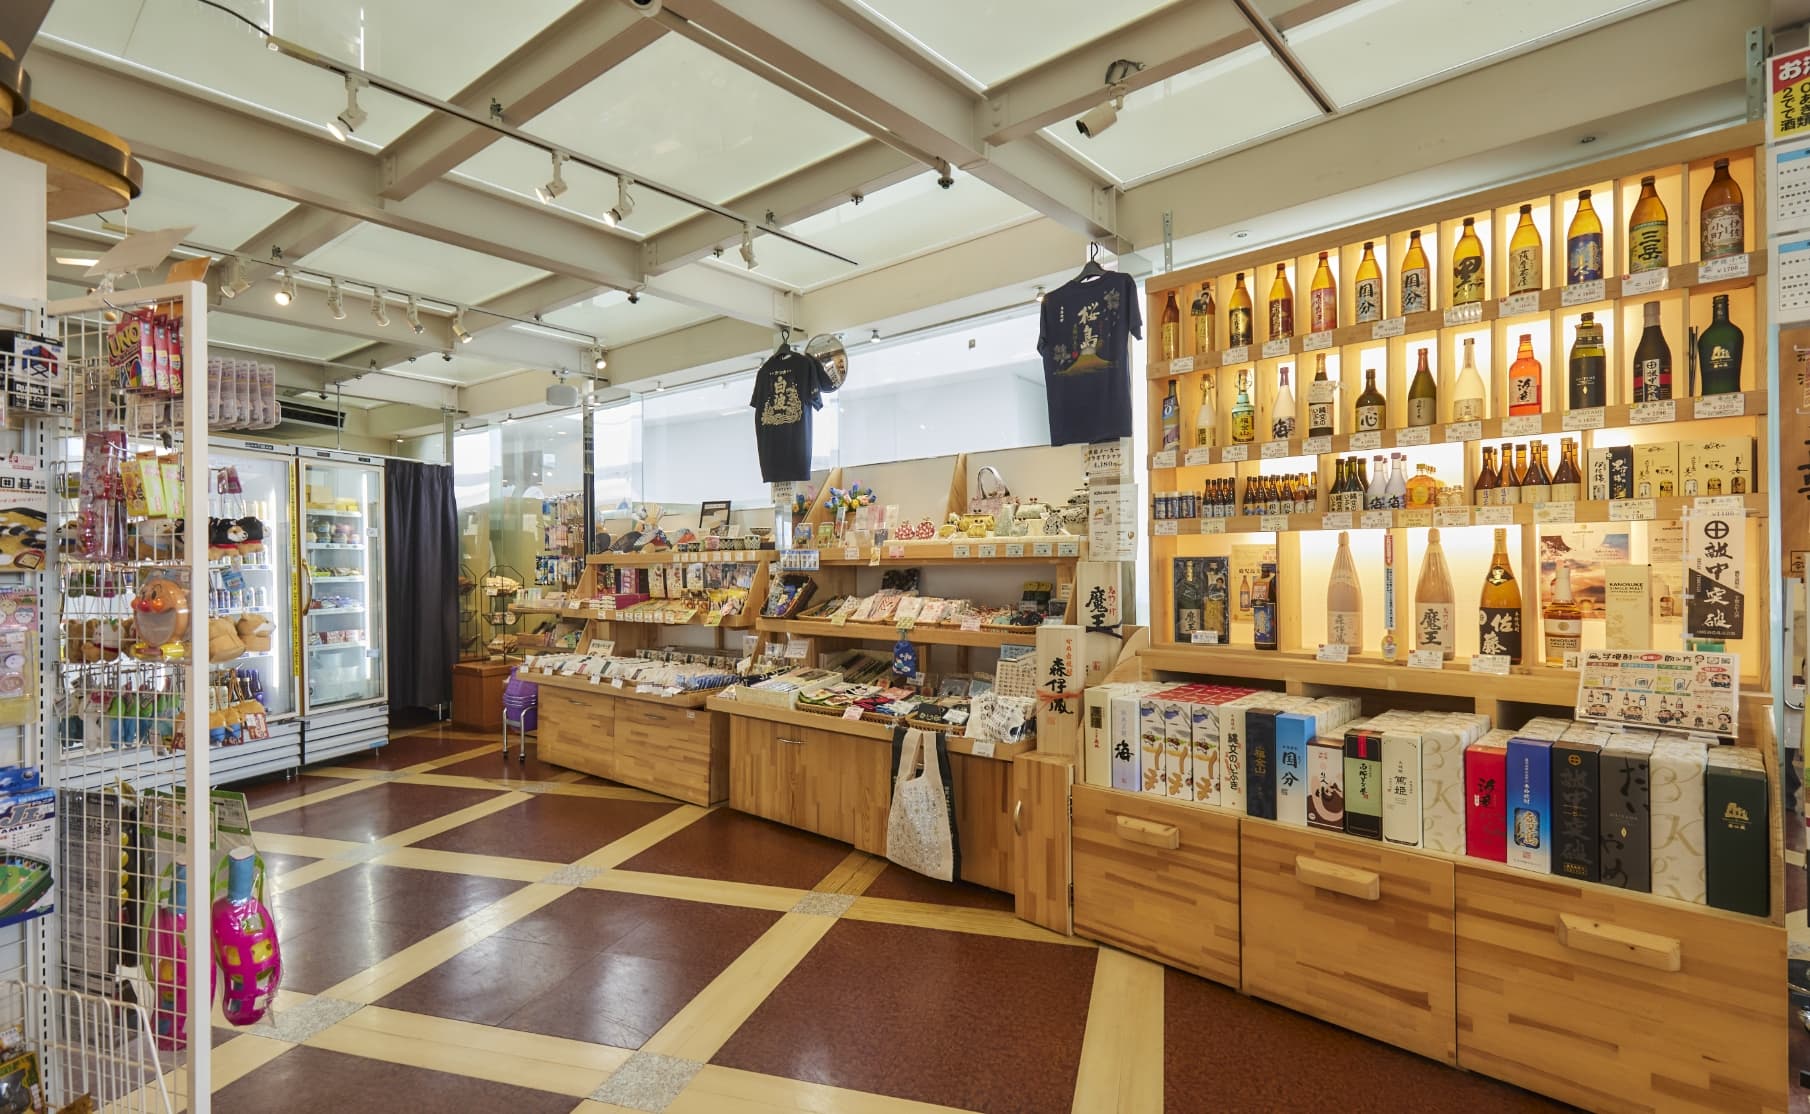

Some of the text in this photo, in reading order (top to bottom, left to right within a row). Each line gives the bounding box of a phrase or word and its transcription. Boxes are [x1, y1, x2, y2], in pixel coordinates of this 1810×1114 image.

[1638, 230, 1663, 261] 三岳
[1358, 283, 1375, 315] 国分
[1404, 272, 1422, 306] 国分
[108, 321, 140, 358] UNO
[1077, 301, 1100, 350] 桜島
[1704, 541, 1733, 630] 敵中突破
[1420, 608, 1442, 646] 魔王
[1481, 613, 1514, 655] 佐藤
[1114, 739, 1135, 762] 海
[1282, 751, 1299, 787] 国分
